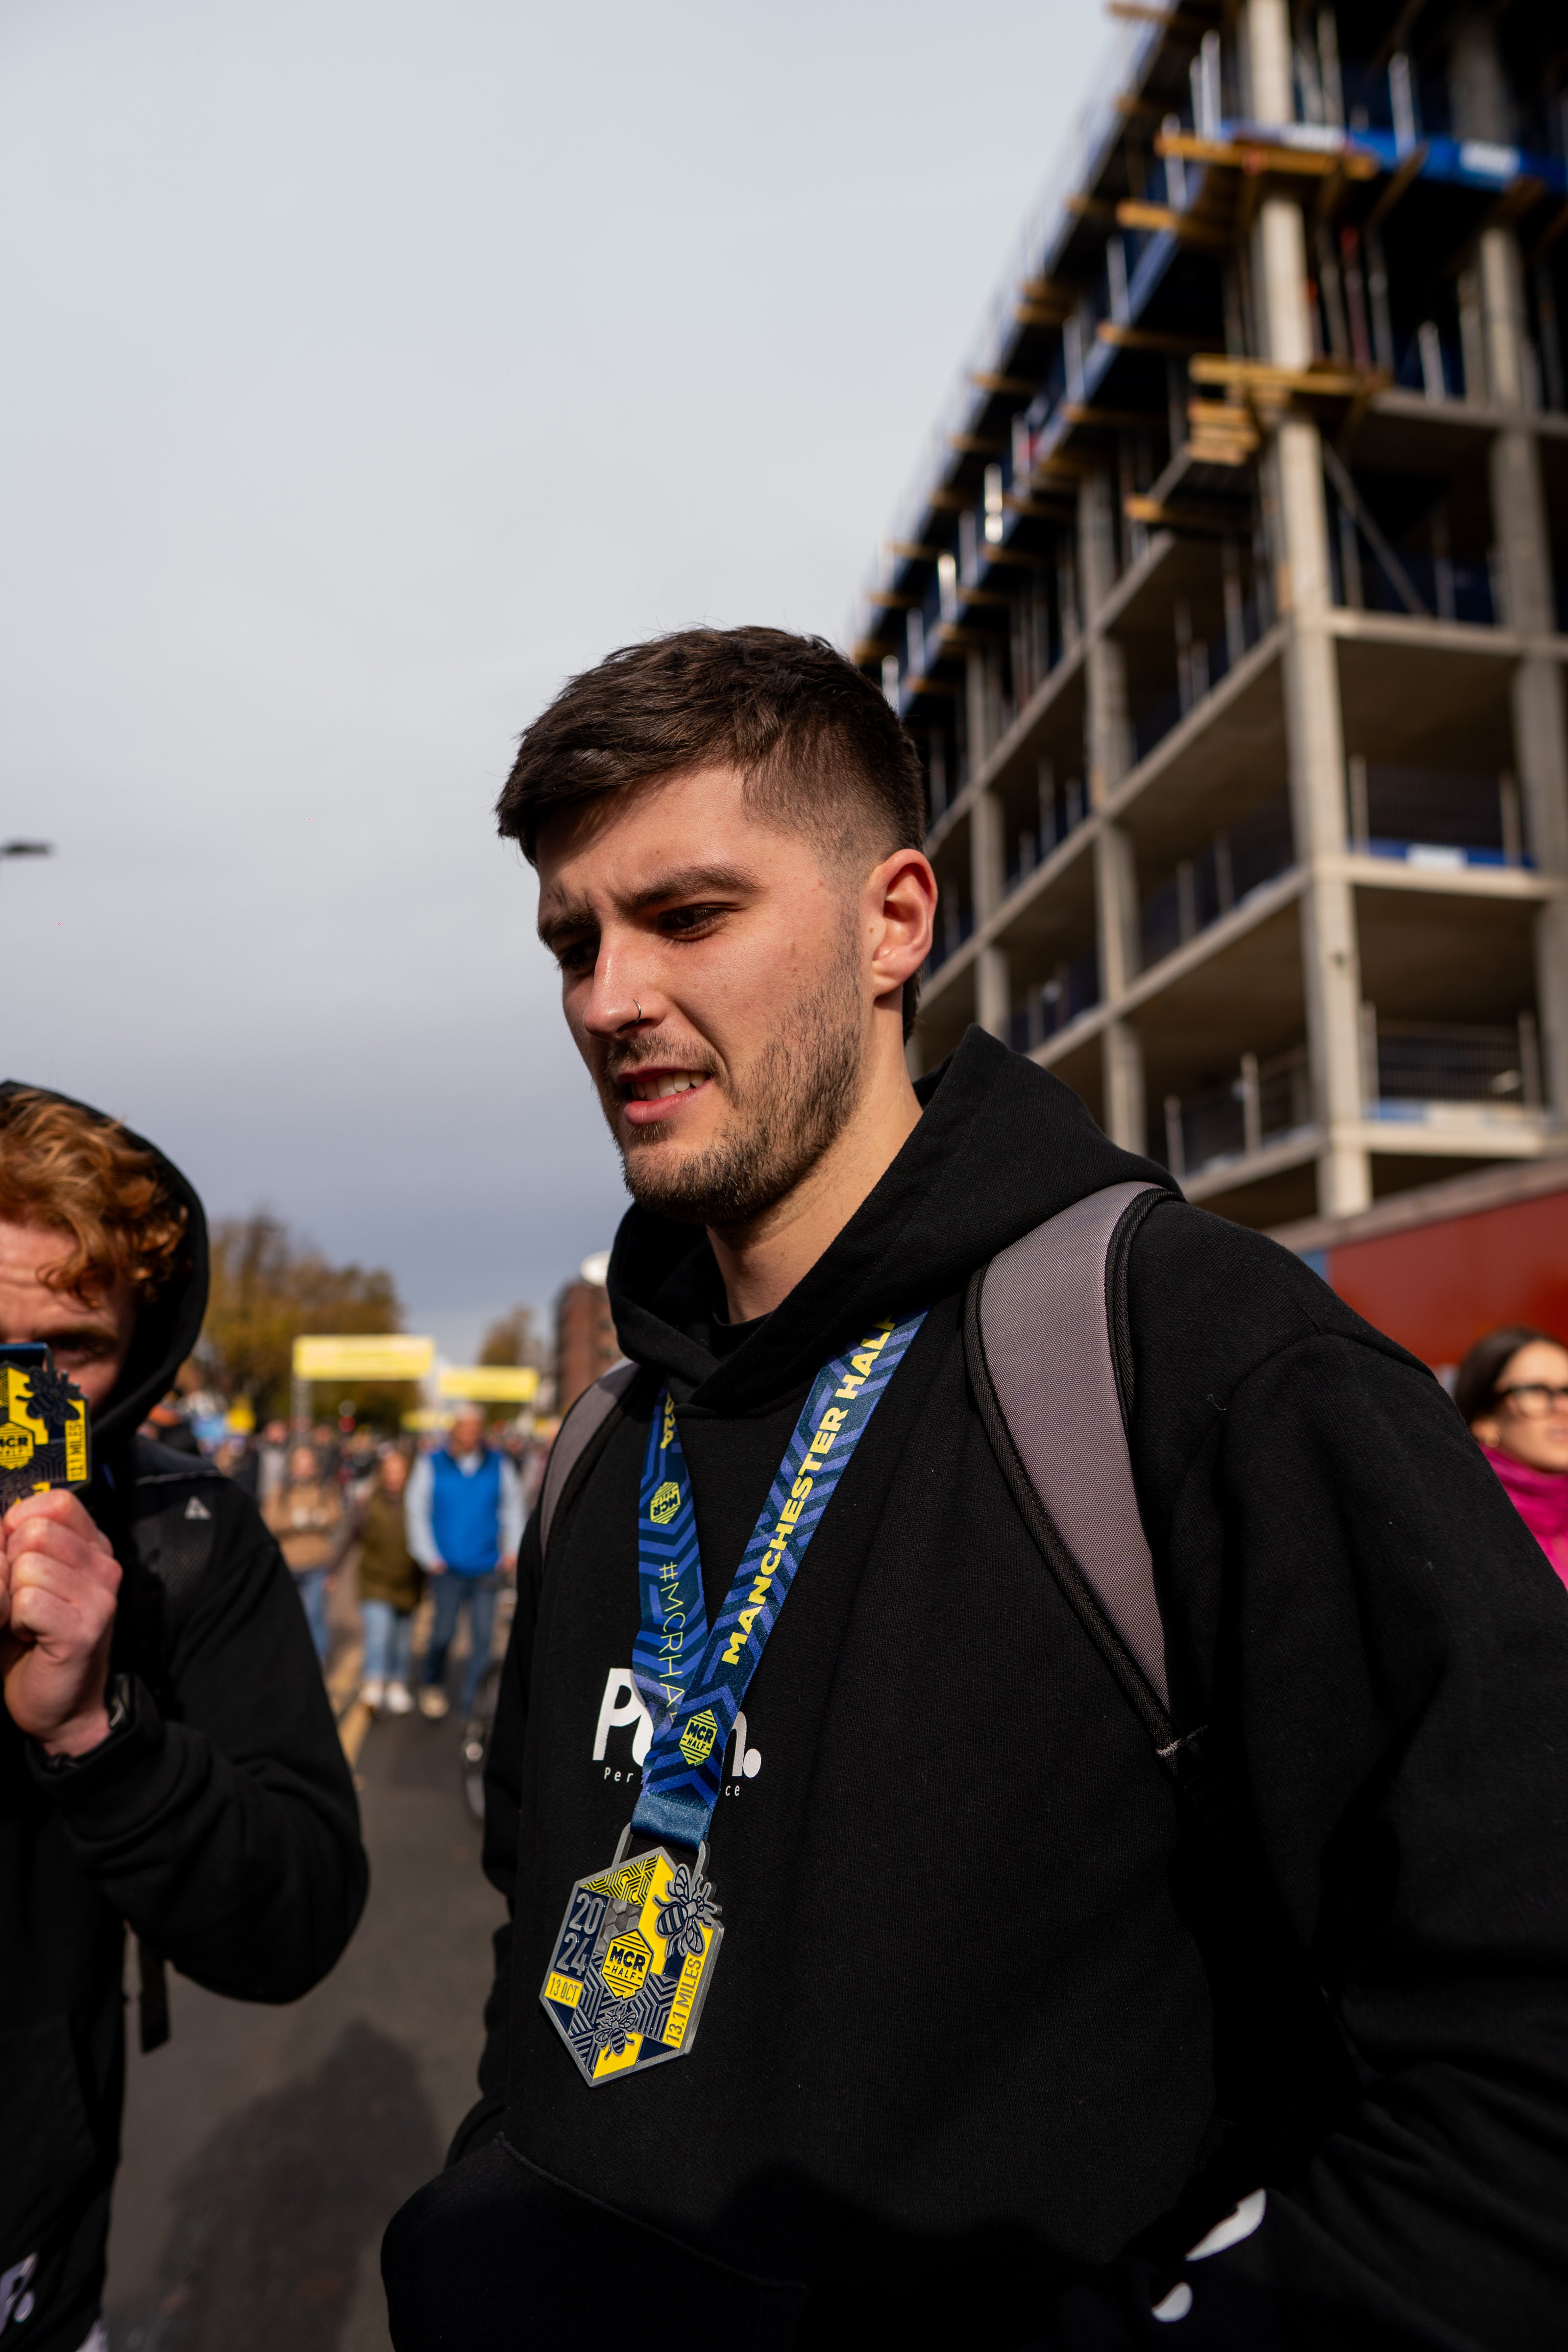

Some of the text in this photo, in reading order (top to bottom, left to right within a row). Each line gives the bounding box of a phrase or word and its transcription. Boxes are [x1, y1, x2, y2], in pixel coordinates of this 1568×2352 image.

[660, 1391, 676, 1449] 024
[653, 1494, 678, 1517] MCR
[721, 1407, 849, 1665] MANCHESTER
[686, 1721, 714, 1744] MCR
[687, 1738, 706, 1750] HALF
[569, 1893, 604, 1935] 20
[556, 1932, 590, 1976] 24
[610, 1945, 646, 1972] MCR
[612, 1965, 636, 1980] HALF
[550, 1977, 580, 2003] 13 OCT
[666, 1958, 701, 2042] 13.1 MILES
